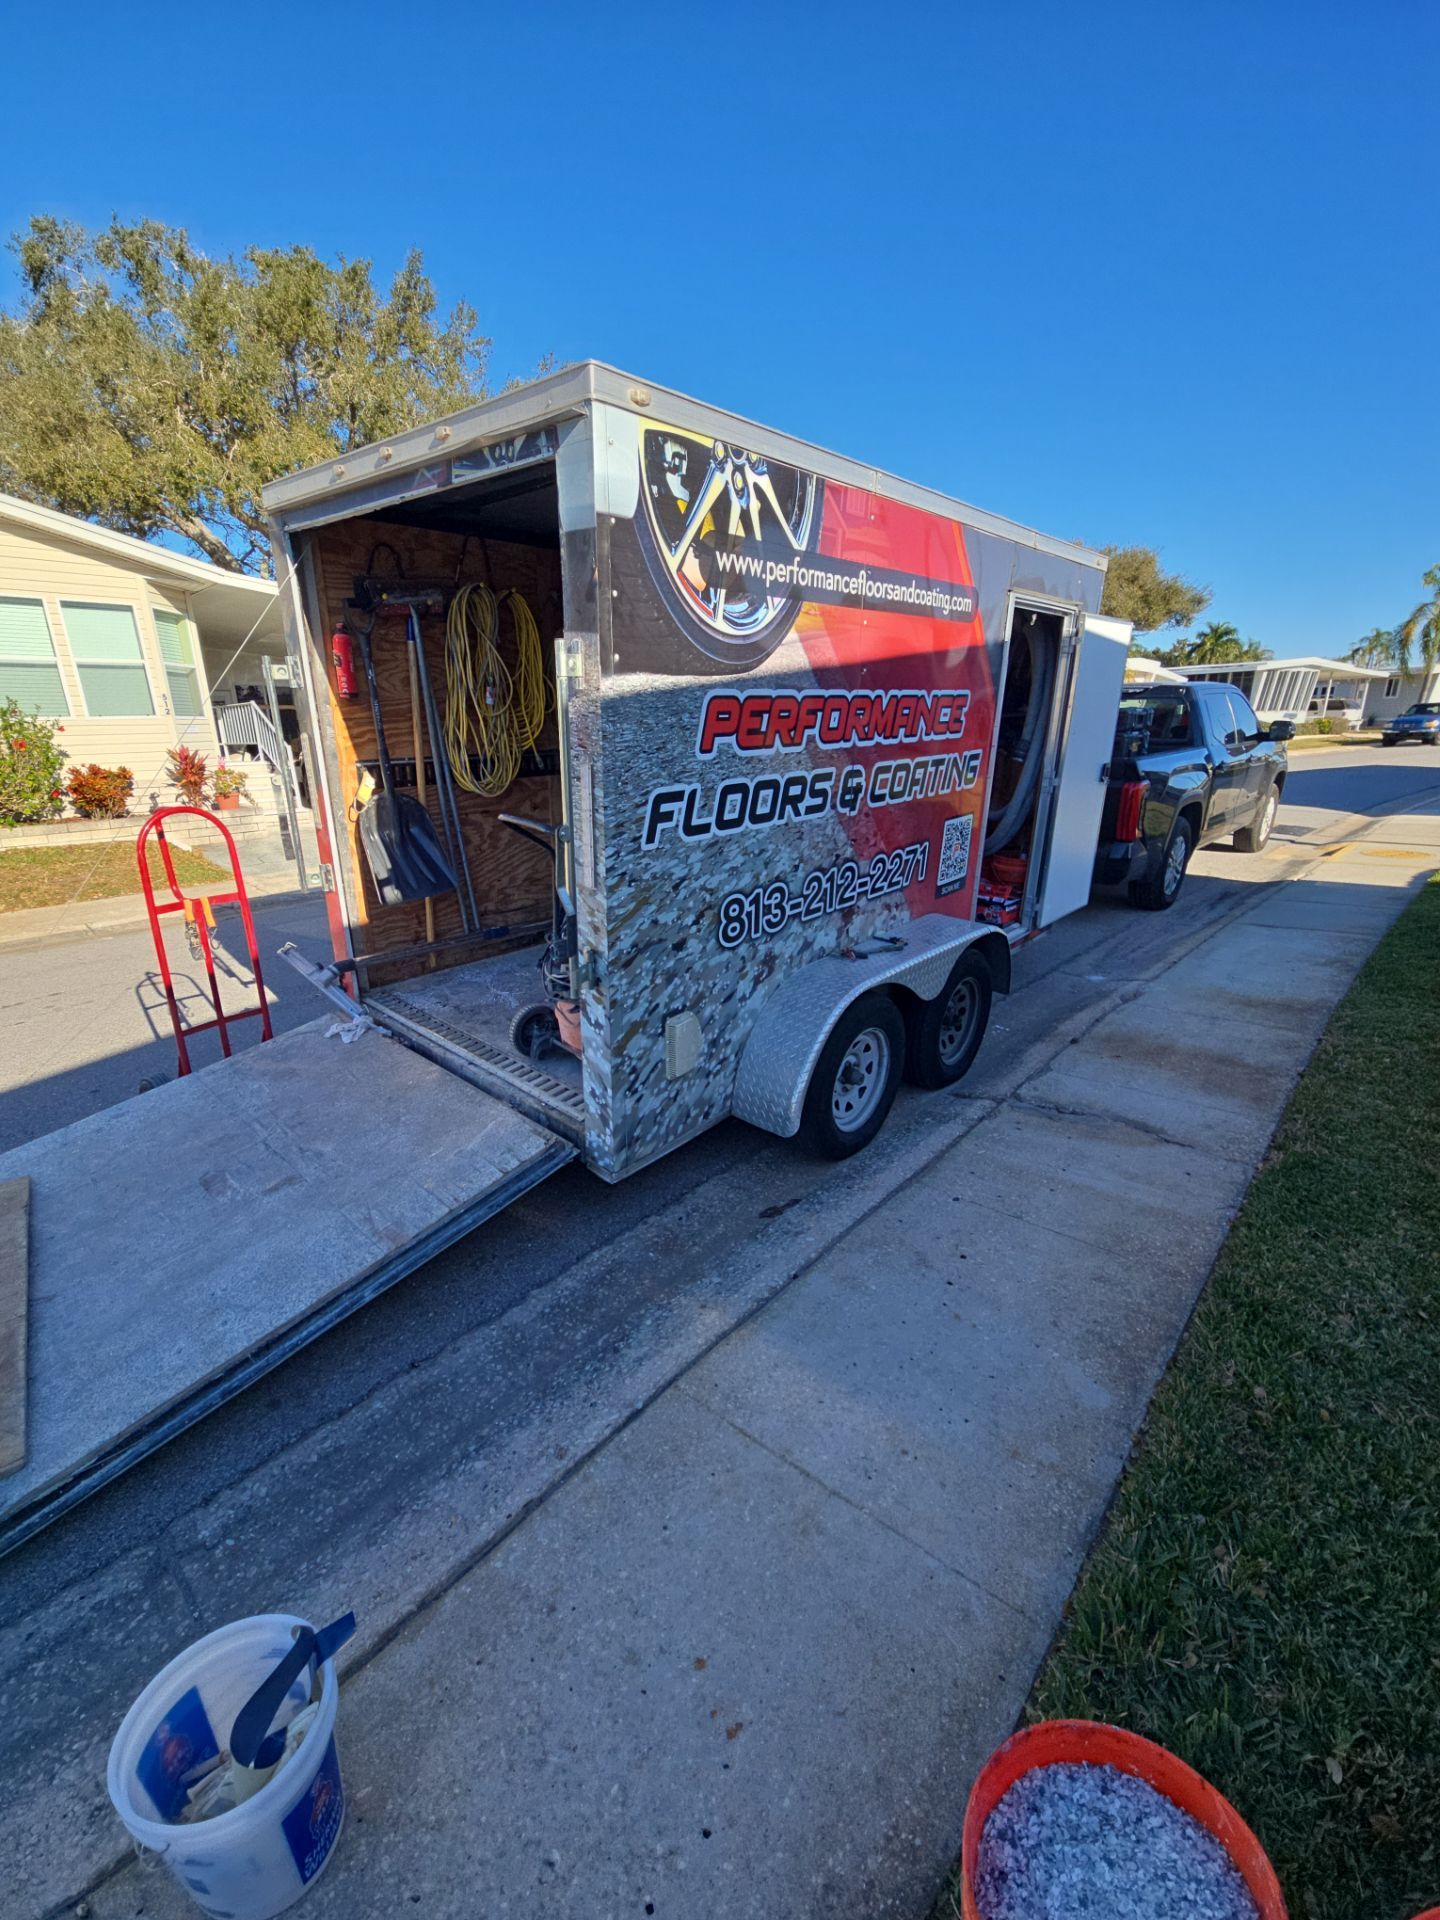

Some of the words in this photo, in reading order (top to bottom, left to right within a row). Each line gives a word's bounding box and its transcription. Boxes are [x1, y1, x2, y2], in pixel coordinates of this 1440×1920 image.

[715, 550, 972, 615] www.performancefloorsandcoating.com
[162, 693, 170, 715] 512
[697, 690, 970, 758] PERFORMANCE
[642, 768, 836, 849] FLOORS
[838, 766, 865, 815] &
[867, 749, 982, 808] COATING
[719, 842, 929, 947] 813-212-2271
